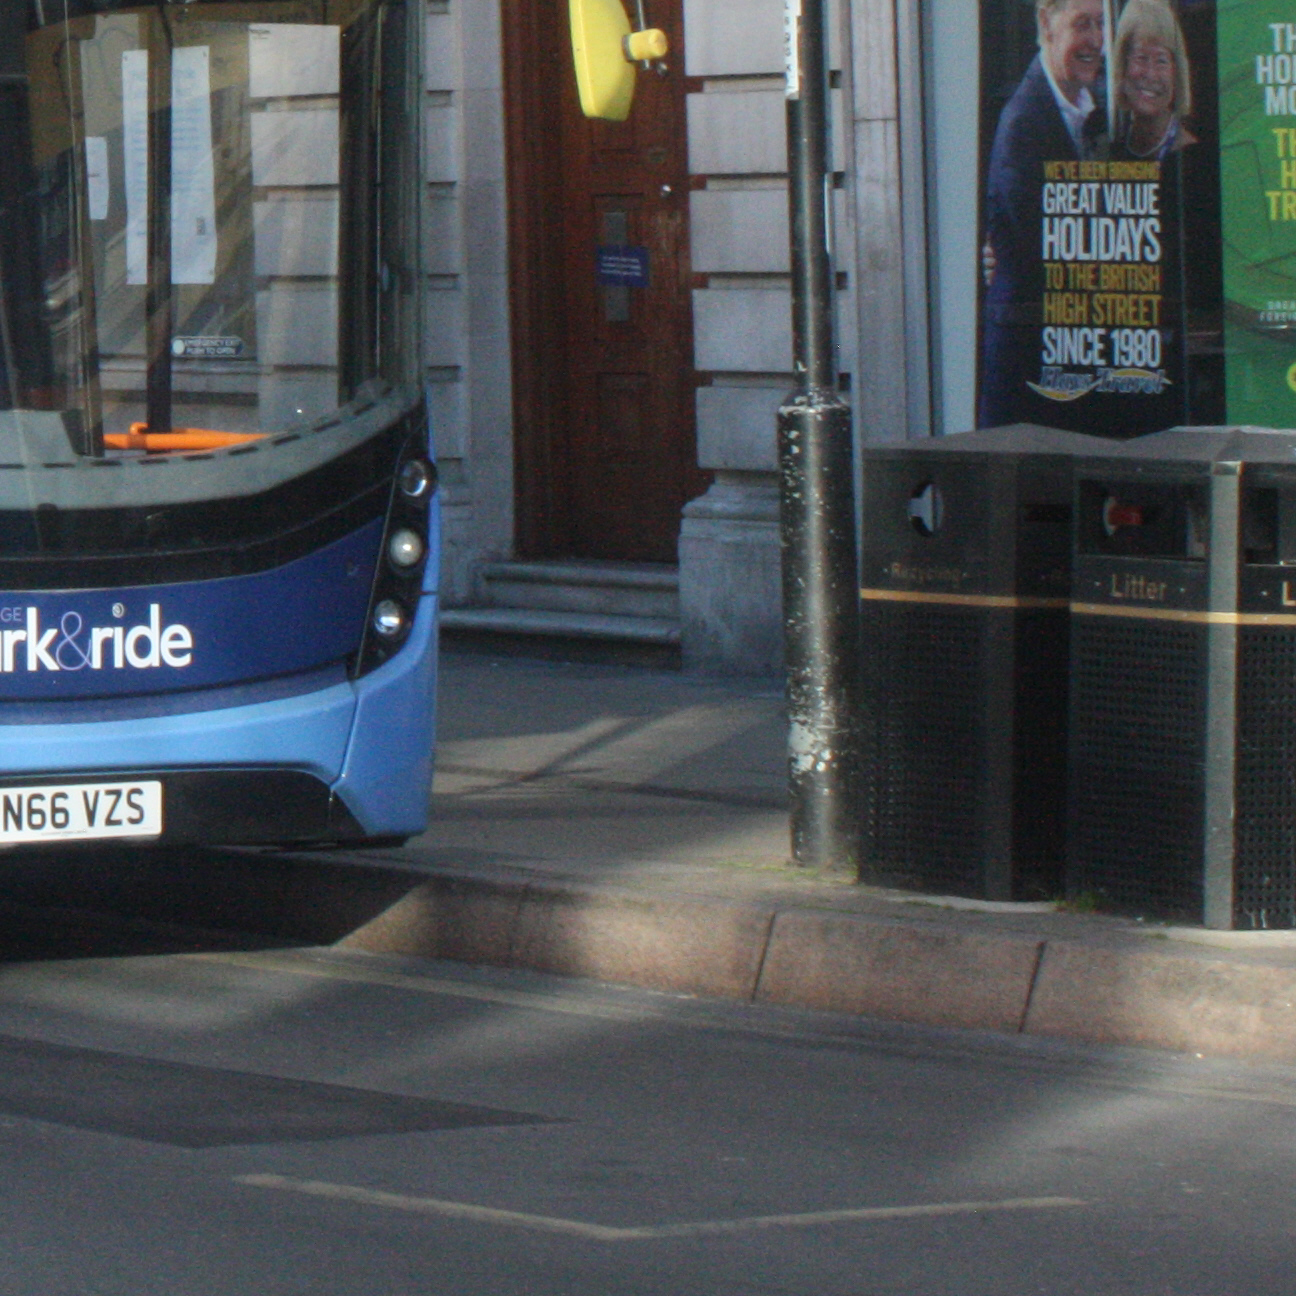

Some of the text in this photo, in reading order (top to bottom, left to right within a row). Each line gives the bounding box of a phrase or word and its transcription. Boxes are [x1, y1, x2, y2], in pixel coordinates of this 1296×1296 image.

[1042, 182, 1160, 215] GREAT VALUE
[1042, 216, 1162, 262] HOLIDAYS
[1044, 263, 1161, 292] TO THE BRITISH
[1043, 291, 1163, 326] HIGH STREET
[1041, 326, 1162, 368] SINCE 1980
[1110, 572, 1168, 600] Litter
[83, 787, 146, 828] VZS
